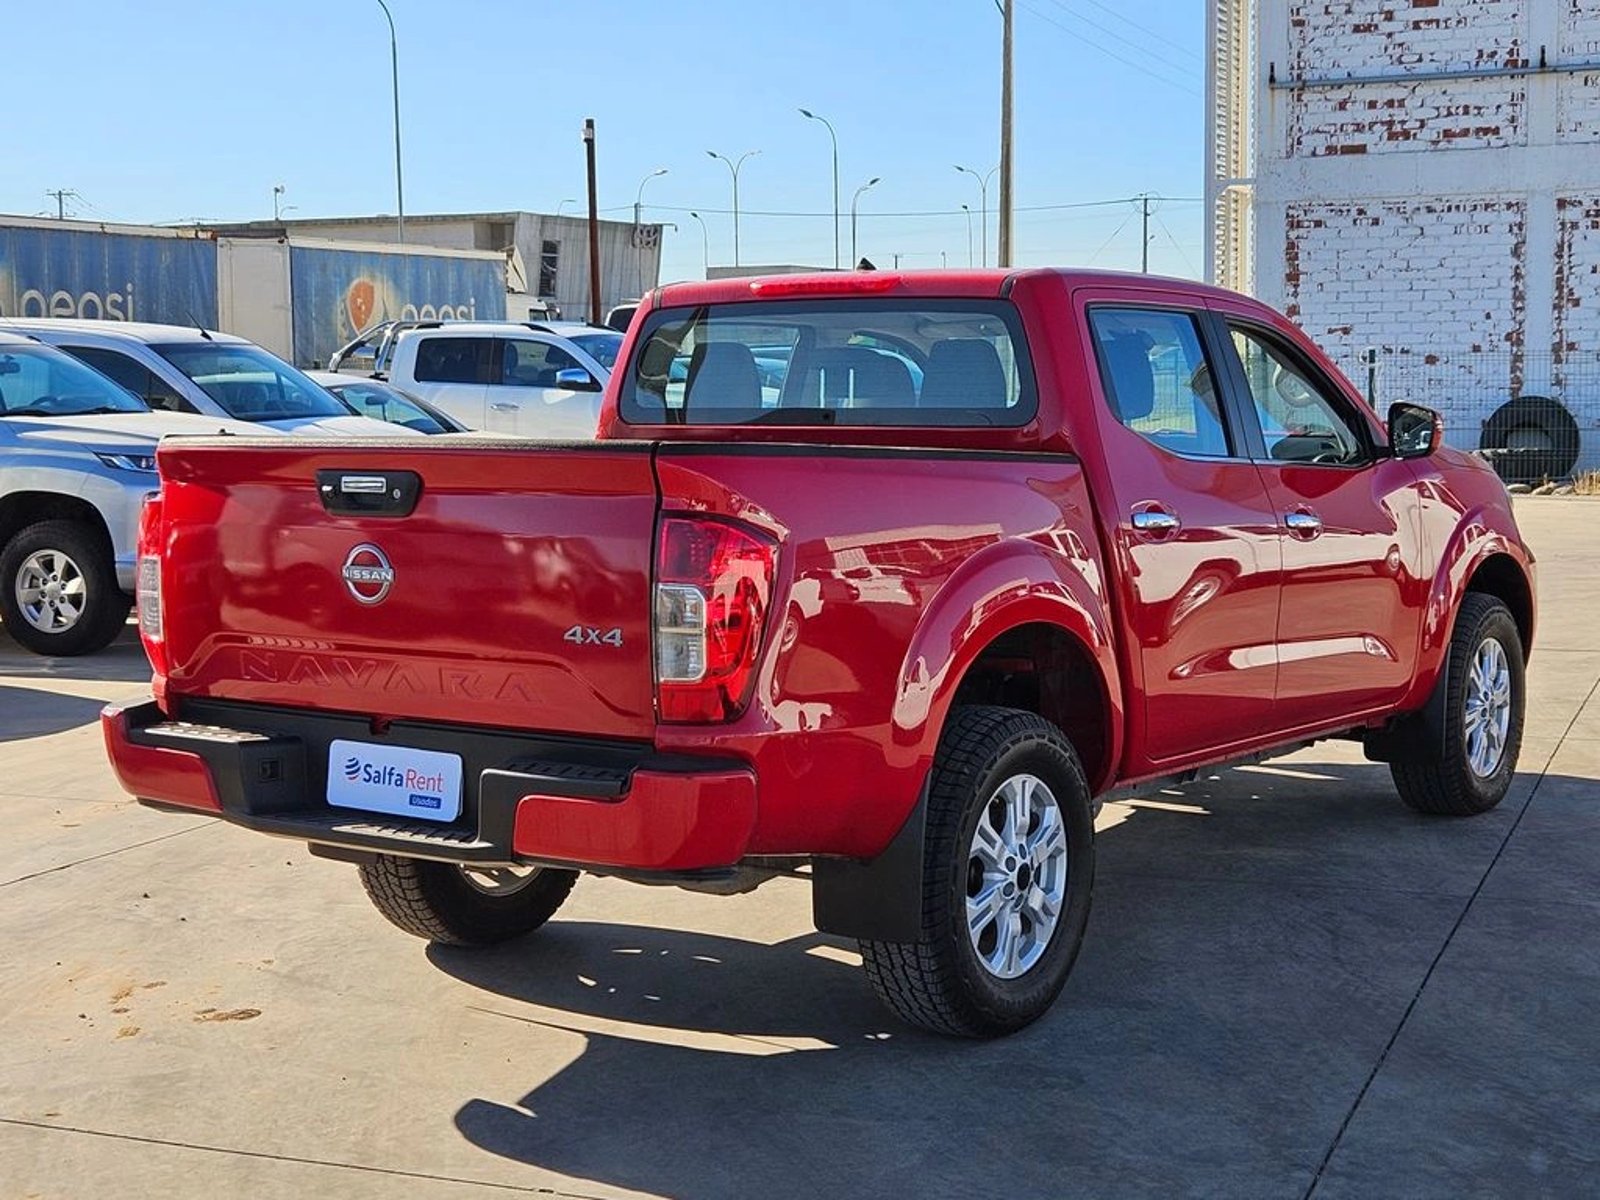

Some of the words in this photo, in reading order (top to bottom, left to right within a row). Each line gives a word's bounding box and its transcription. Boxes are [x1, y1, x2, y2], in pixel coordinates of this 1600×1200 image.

[343, 567, 392, 580] NISSAN
[239, 649, 543, 703] NAVARA
[363, 763, 443, 793] SalfaRent
